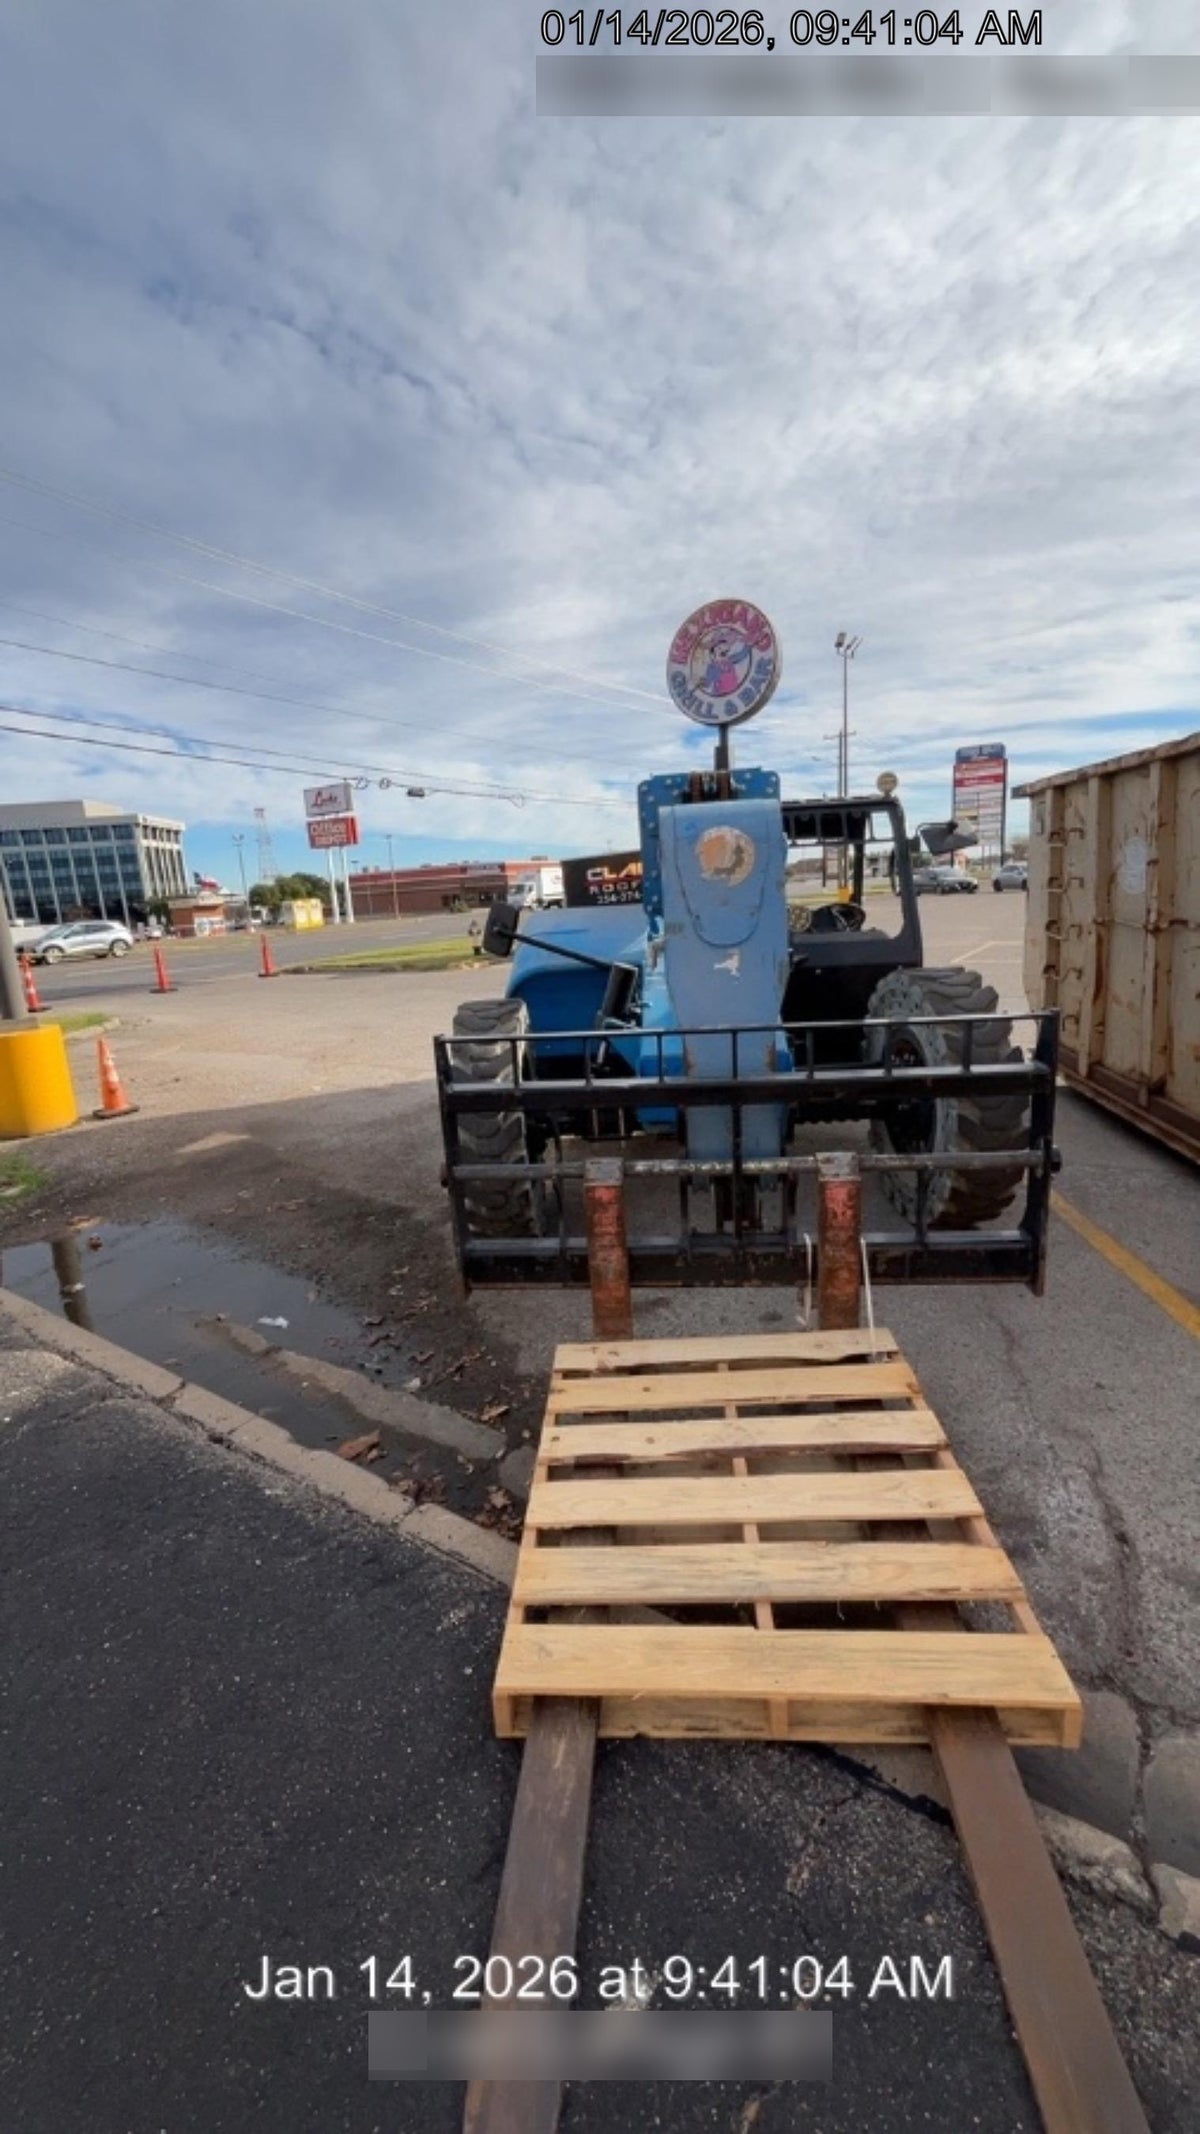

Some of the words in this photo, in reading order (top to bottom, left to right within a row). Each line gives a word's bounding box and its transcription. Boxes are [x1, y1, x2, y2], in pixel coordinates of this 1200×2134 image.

[670, 670, 719, 720] GRILL
[737, 657, 773, 708] BAR
[311, 822, 346, 835] Office
